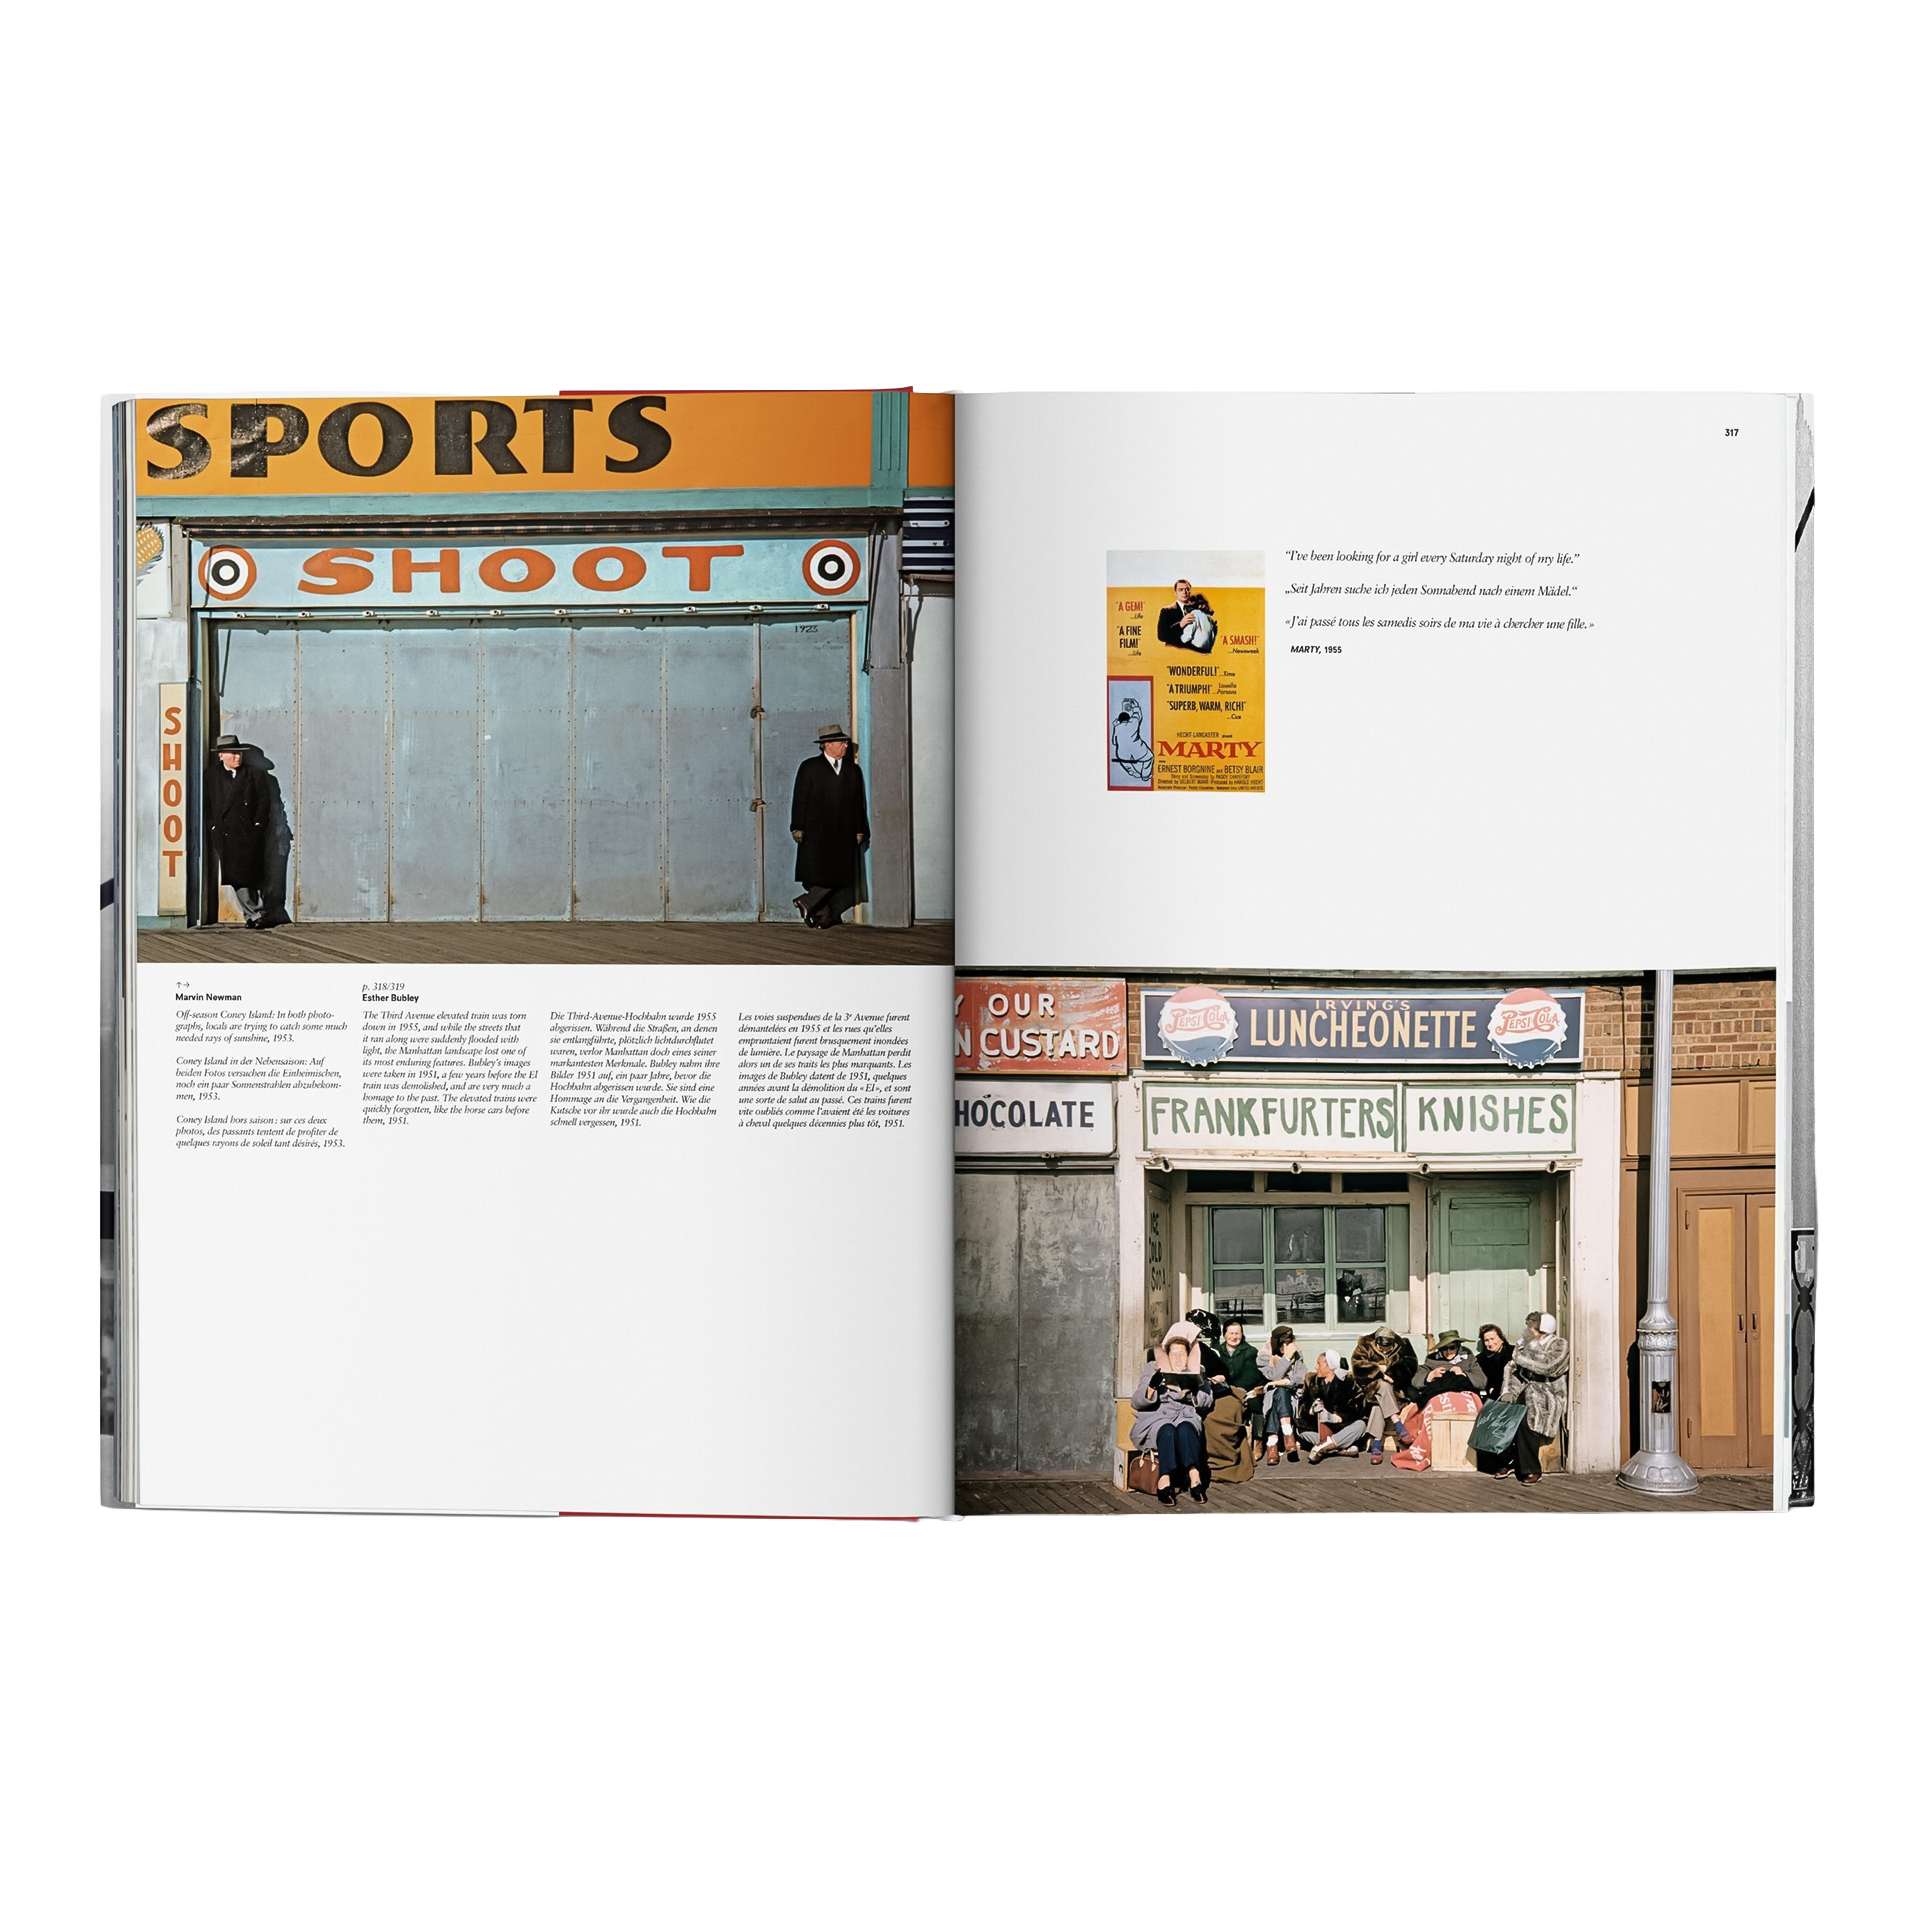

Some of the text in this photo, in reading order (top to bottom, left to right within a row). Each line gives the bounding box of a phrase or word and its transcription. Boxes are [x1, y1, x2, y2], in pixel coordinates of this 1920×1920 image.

[146, 395, 672, 480] SPORTS
[1725, 428, 1739, 436] 317
[1310, 549, 1334, 561] been
[1336, 550, 1374, 564] looking
[1375, 550, 1391, 565] for
[1392, 554, 1399, 562] a
[1400, 551, 1419, 564] girl
[1420, 554, 1447, 565] every
[1448, 551, 1494, 565] Saturday
[1496, 552, 1522, 566] night
[1524, 552, 1537, 566] of
[1537, 556, 1554, 566] my
[297, 545, 744, 595] SHOOT
[1309, 582, 1342, 596] Jahren
[1344, 583, 1372, 594] suche
[1374, 583, 1389, 594] ich
[1390, 583, 1418, 597] jeden
[1420, 584, 1477, 595] Sonnabend
[1478, 584, 1502, 596] nach
[1504, 585, 1535, 596] einem
[1309, 616, 1336, 629] passé
[1338, 617, 1360, 627] tous
[1362, 616, 1375, 627] les
[1376, 616, 1417, 628] samedis
[1418, 617, 1442, 628] soirs
[1443, 616, 1457, 628] de
[1477, 618, 1492, 628] vie
[1493, 618, 1501, 628] à
[1503, 617, 1544, 629] chercher
[1546, 621, 1565, 629] une
[1126, 626, 1141, 635] FINE
[1290, 645, 1342, 654] MARTY, 1955
[1157, 741, 1262, 759] MARTY
[1158, 765, 1182, 773] ERNEST
[1183, 765, 1215, 774] BORGNINE
[1224, 765, 1244, 774] BETSY
[1245, 765, 1264, 774] BLAIR
[162, 706, 183, 877] SHOOT
[372, 982, 405, 990] 318/319
[175, 993, 242, 1001] Marvin Newman
[362, 993, 419, 1003] Esther Bubley
[988, 993, 1054, 1017] OUR
[1315, 1000, 1411, 1010] IRVING'S
[175, 1009, 334, 1021] Off-season Coney Island: In both photo-
[363, 1010, 378, 1019] The
[380, 1010, 403, 1019] Third
[404, 1011, 435, 1019] Avenue
[436, 1010, 469, 1019] elevated
[470, 1011, 490, 1019] train
[550, 1011, 717, 1021] Die Third-Avenue-Hochbahn wurde 1955
[174, 1021, 203, 1032] graphs,
[205, 1021, 227, 1030] locals
[243, 1022, 267, 1032] trying
[279, 1021, 300, 1030] catch
[324, 1022, 348, 1030] much
[549, 1022, 592, 1034] abgerissen.
[595, 1023, 631, 1032] Während
[632, 1023, 645, 1032] die
[647, 1023, 679, 1034] Straßen,
[693, 1023, 718, 1032] denen
[1250, 1008, 1477, 1048] LUNCHEONETTE
[175, 1033, 294, 1044] needed rays of sunshine, 1953.
[738, 1035, 909, 1047] empruntaient furent brusquement inondées
[980, 1028, 1120, 1059] CUSTARD
[175, 1068, 341, 1078] beiden Fotos versuchen die Einheimischen,
[362, 1115, 409, 1125] them, 1951.
[1151, 1097, 1394, 1138] FRANKFURTERS
[1419, 1094, 1568, 1134] KNISHES
